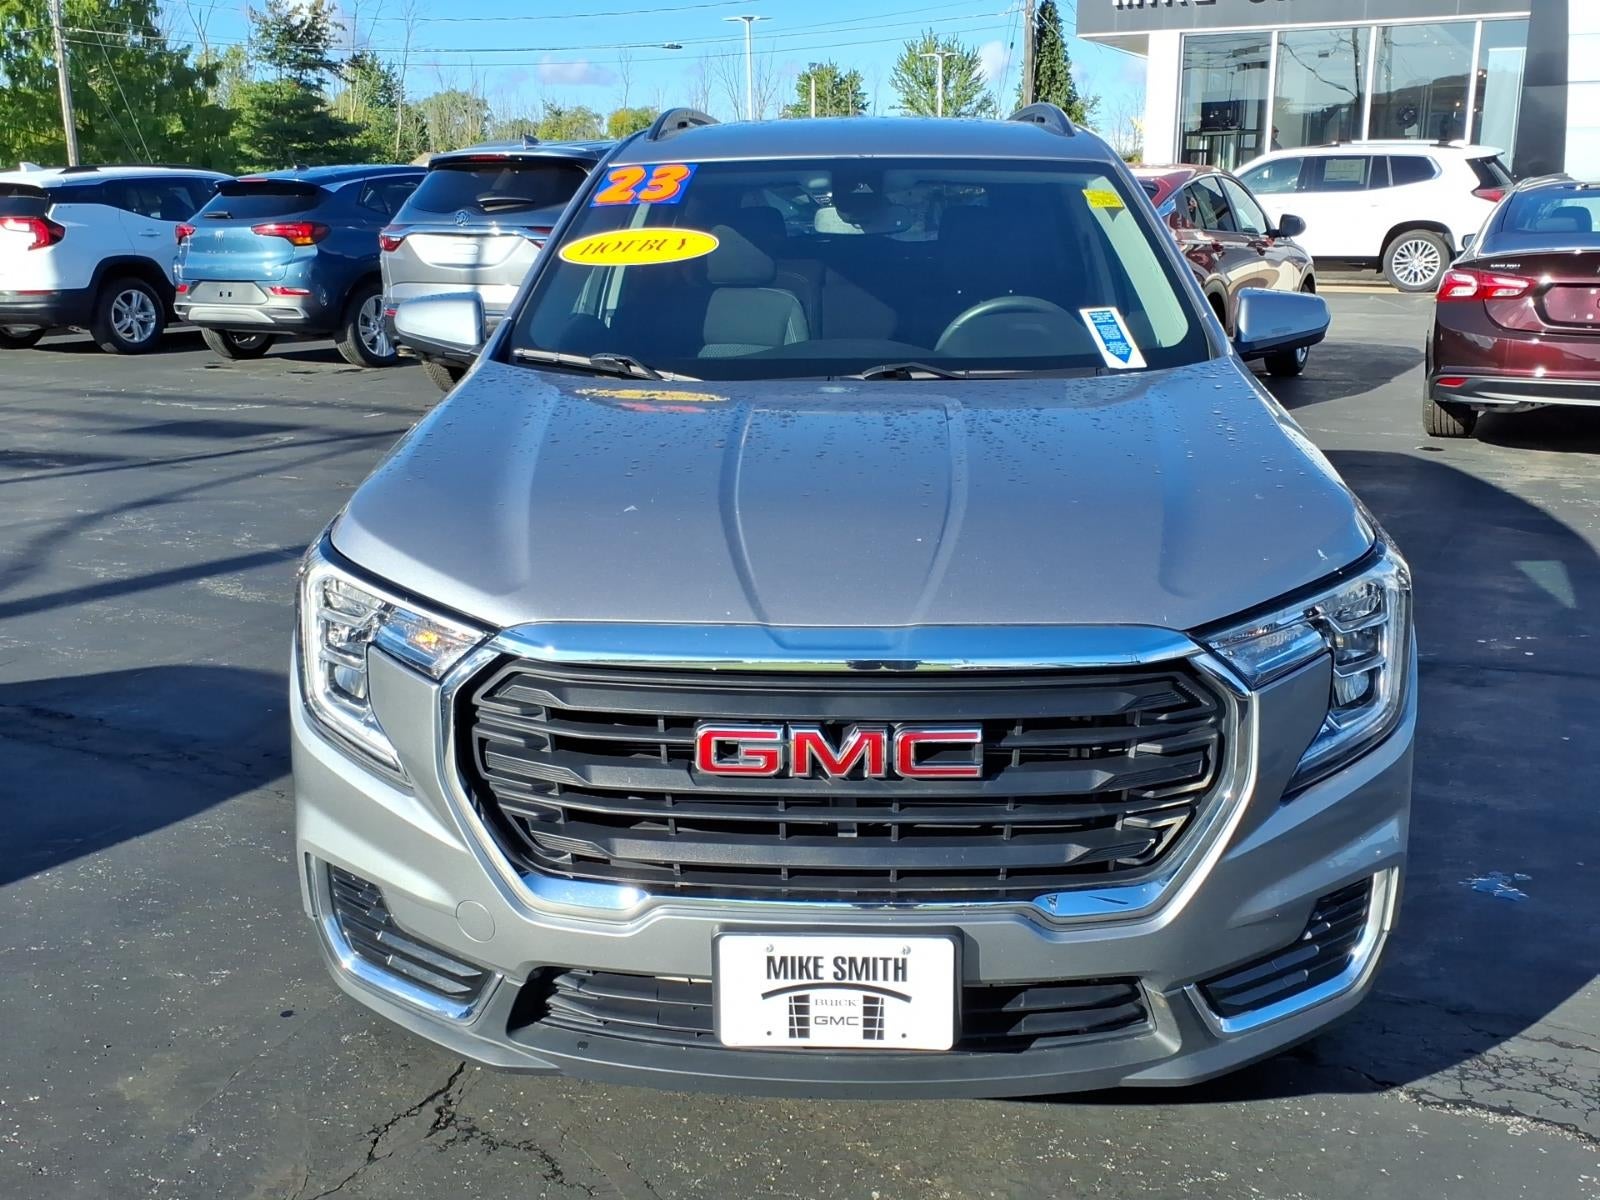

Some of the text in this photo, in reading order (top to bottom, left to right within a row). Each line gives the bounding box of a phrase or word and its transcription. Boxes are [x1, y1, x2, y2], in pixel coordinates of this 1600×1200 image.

[594, 164, 691, 204] 23
[694, 720, 983, 778] GMC
[766, 955, 908, 982] MIKE SMITH
[814, 998, 858, 1008] BUICK
[814, 1015, 859, 1026] GMC
